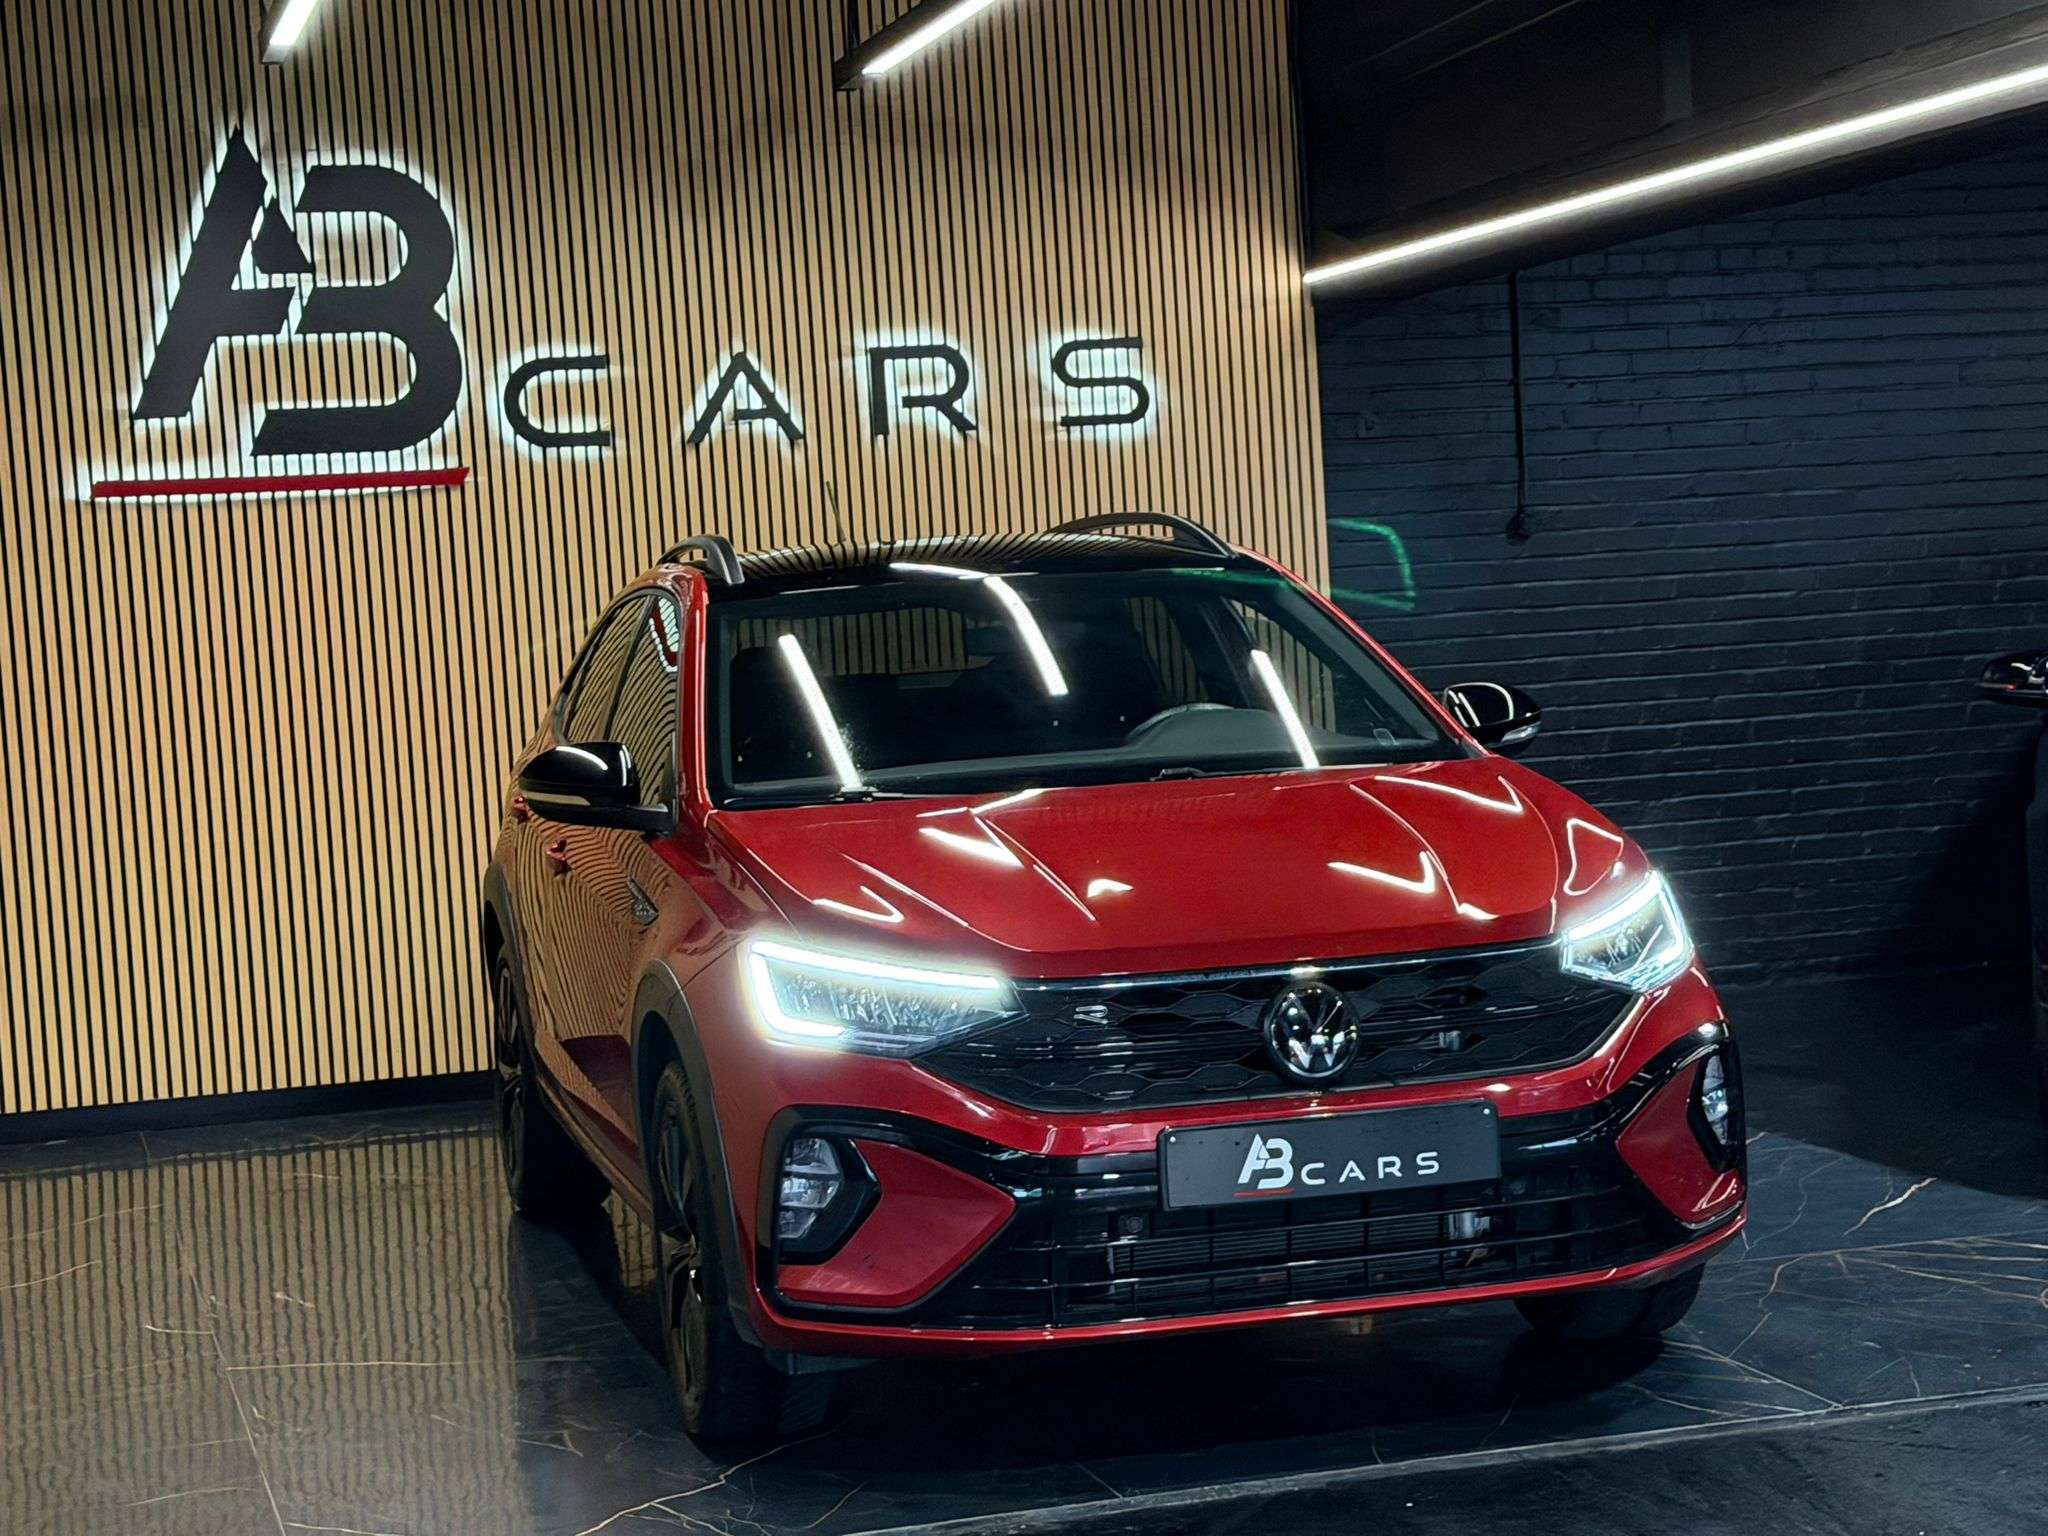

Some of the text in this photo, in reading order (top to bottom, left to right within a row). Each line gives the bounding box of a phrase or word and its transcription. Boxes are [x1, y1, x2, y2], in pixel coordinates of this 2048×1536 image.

[134, 126, 1150, 456] AB CARS
[1237, 1133, 1440, 1189] AB CARS
